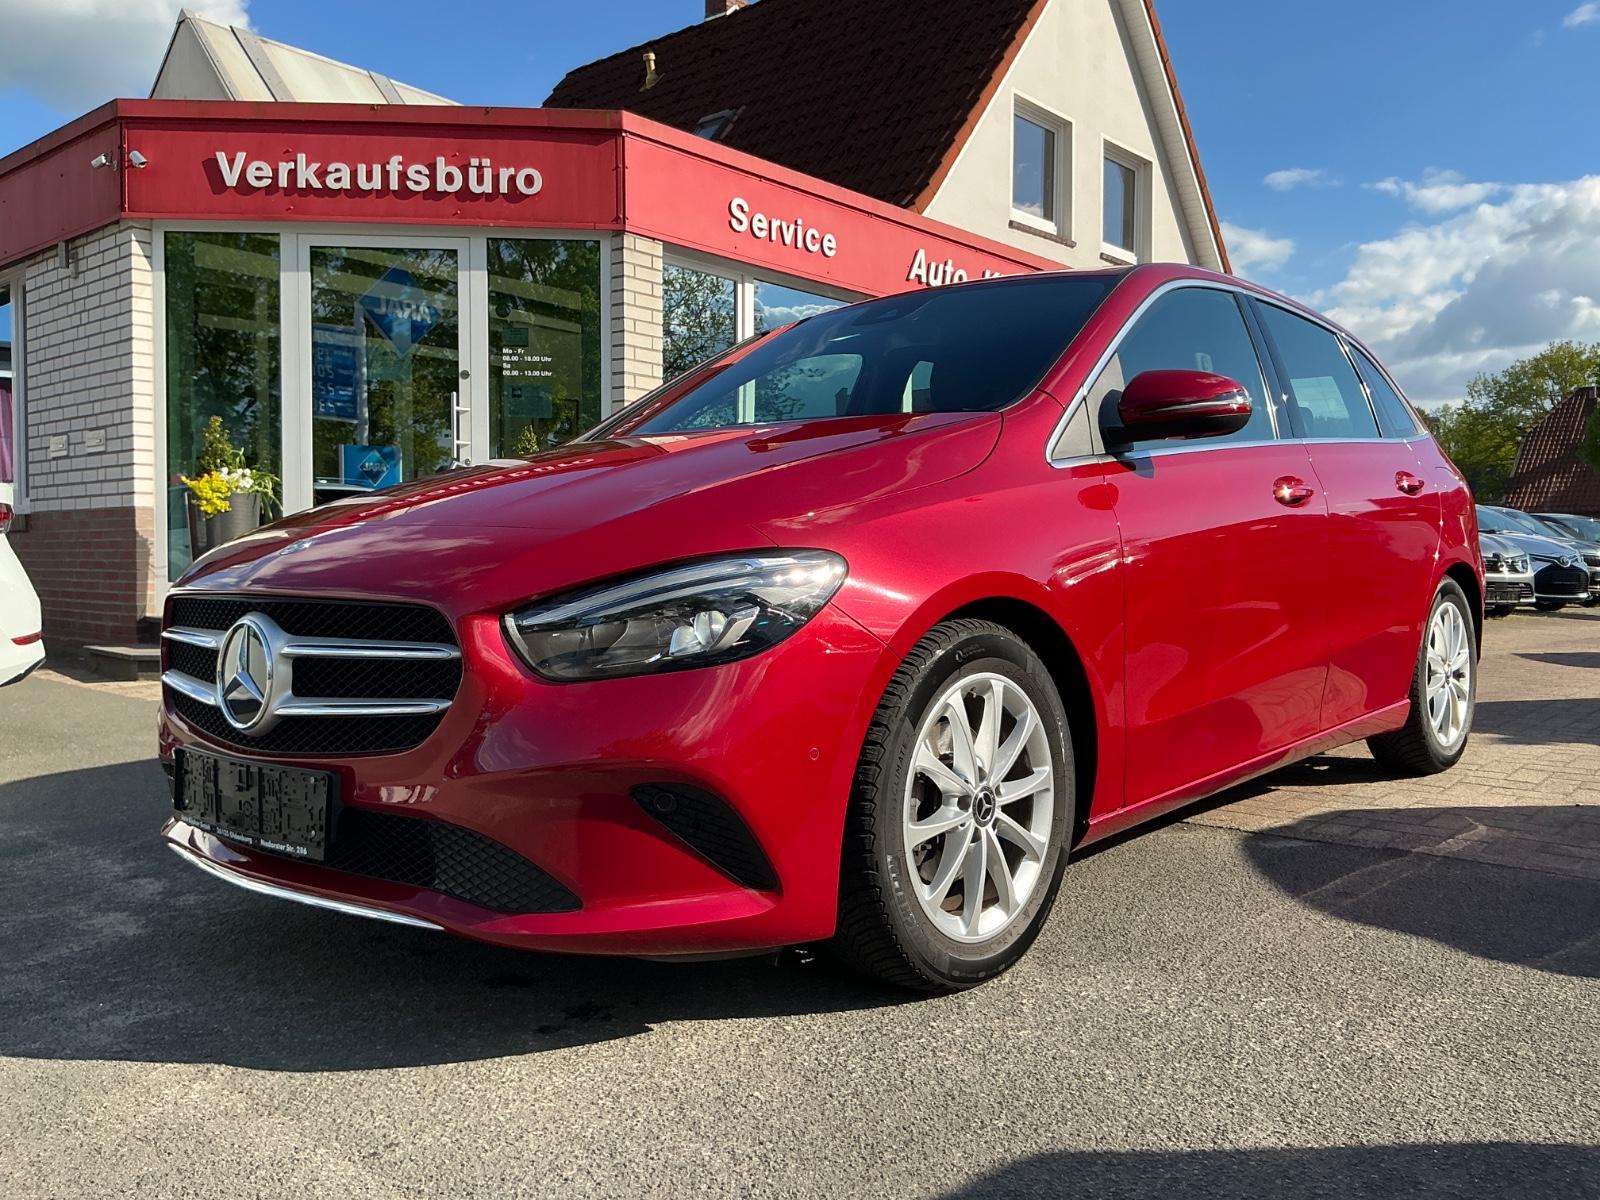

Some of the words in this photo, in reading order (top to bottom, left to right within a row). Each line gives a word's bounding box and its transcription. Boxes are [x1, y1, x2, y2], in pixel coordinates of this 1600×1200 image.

[215, 151, 543, 196] Verkaufsbüro
[729, 197, 837, 257] Service
[908, 248, 968, 287] Auto
